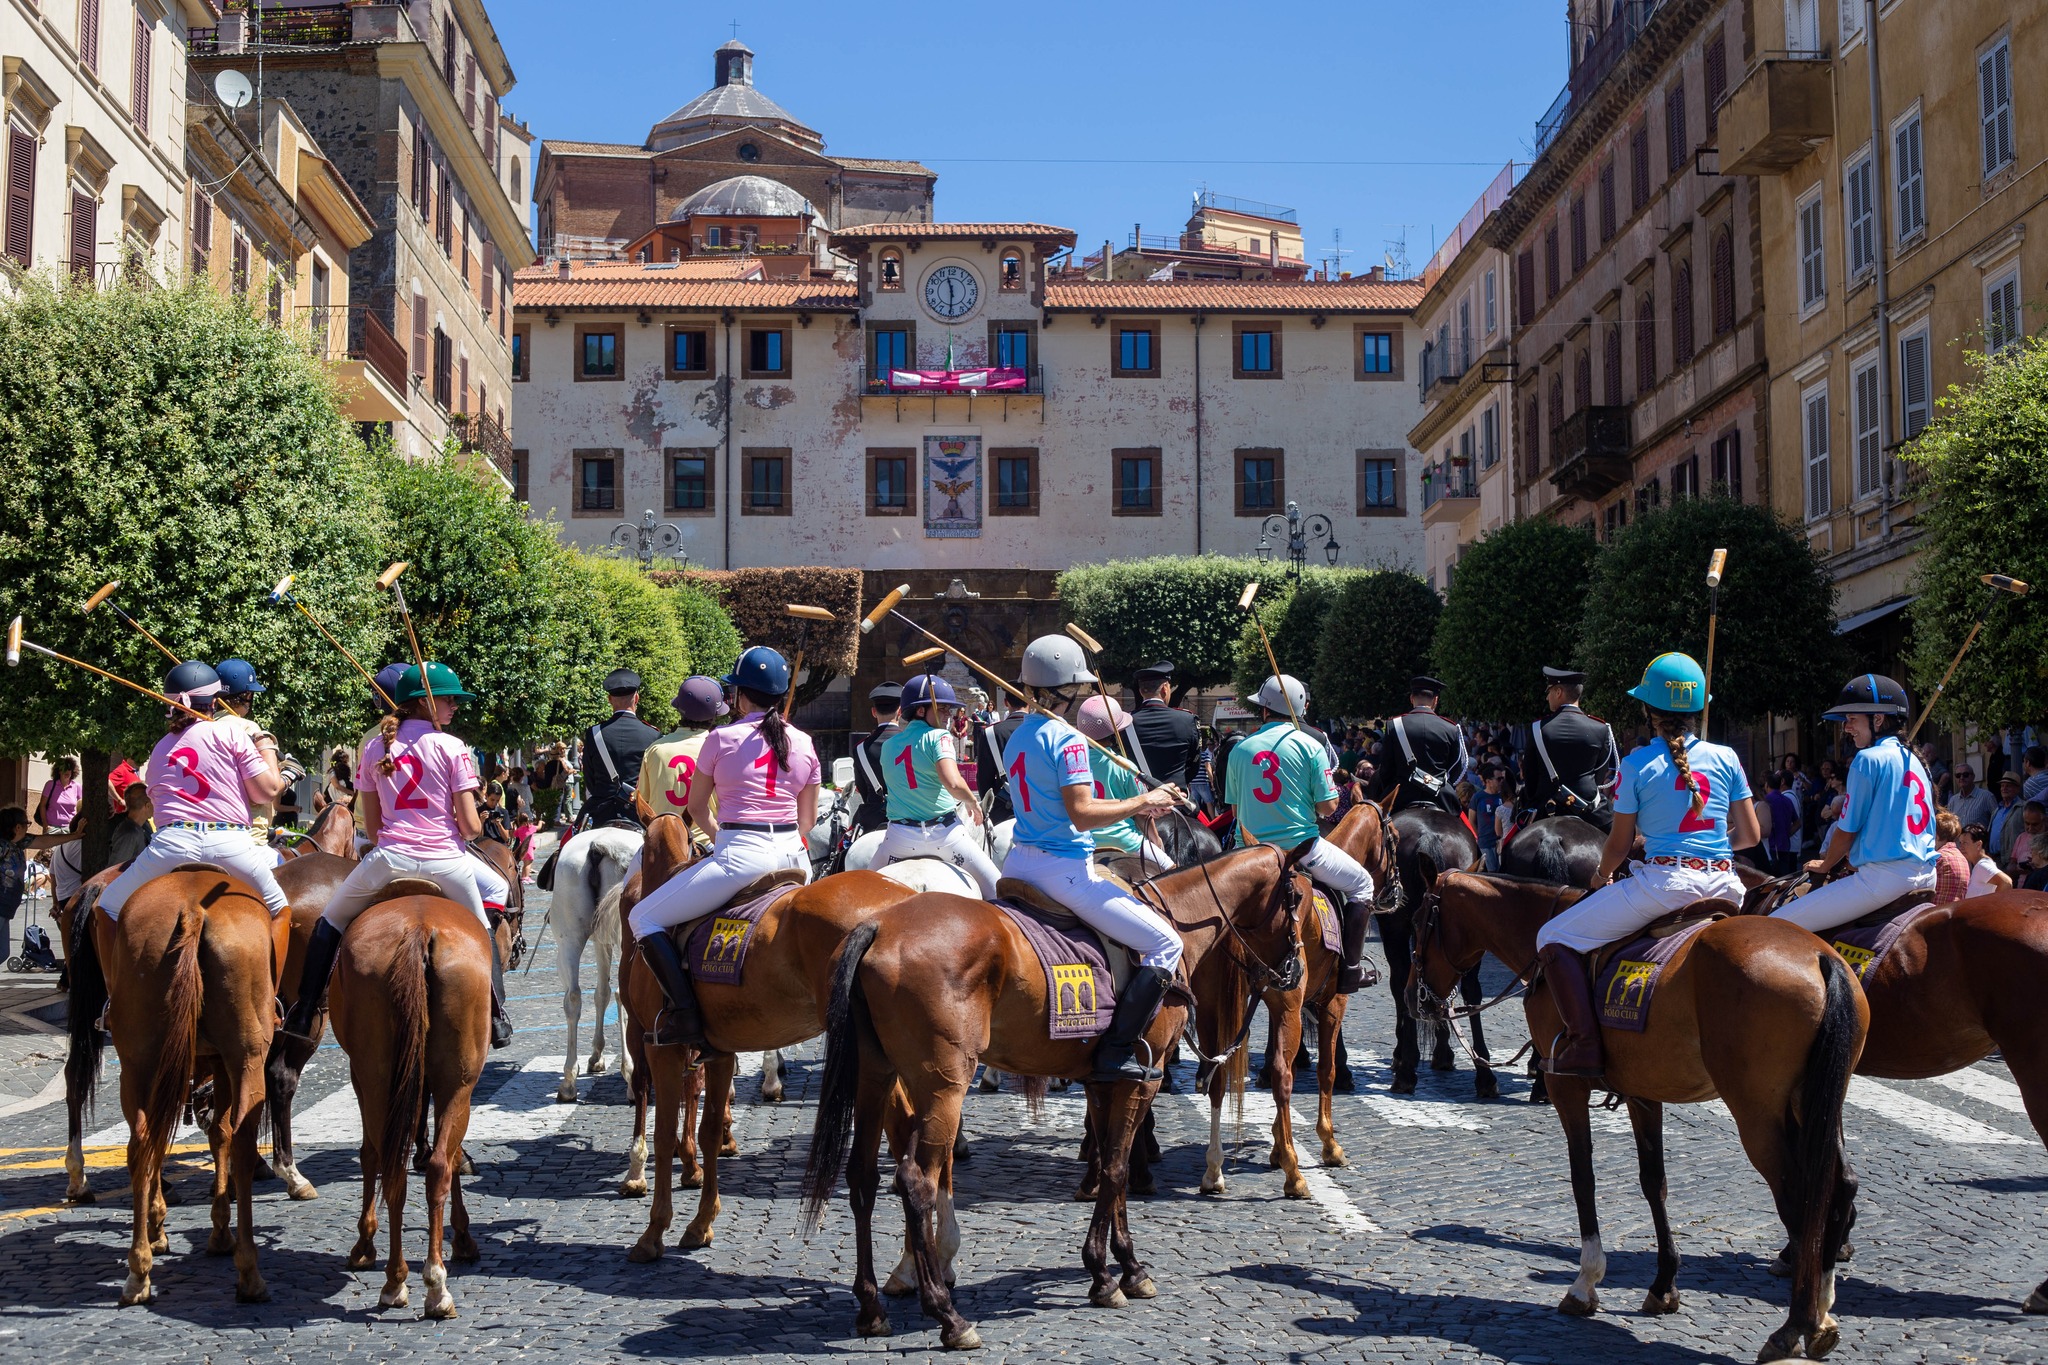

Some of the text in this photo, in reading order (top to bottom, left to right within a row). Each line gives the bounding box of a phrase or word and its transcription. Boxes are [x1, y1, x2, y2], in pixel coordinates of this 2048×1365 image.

[930, 277, 939, 285] 10
[947, 268, 956, 276] 12
[166, 746, 211, 804] 3
[394, 754, 428, 810] 2
[665, 755, 696, 807] 3
[753, 746, 778, 798] 1
[894, 744, 918, 790] 1
[1009, 751, 1032, 812] 1
[1251, 750, 1282, 804] 3
[1674, 770, 1715, 833] 2
[1840, 793, 1851, 820] 3
[1903, 770, 1930, 836] 3
[701, 963, 717, 973] POLO
[718, 964, 734, 974] CLUB
[1057, 1017, 1096, 1027] POLO CLUB
[1604, 1007, 1620, 1018] POLO
[1621, 1009, 1638, 1020] CLUB
